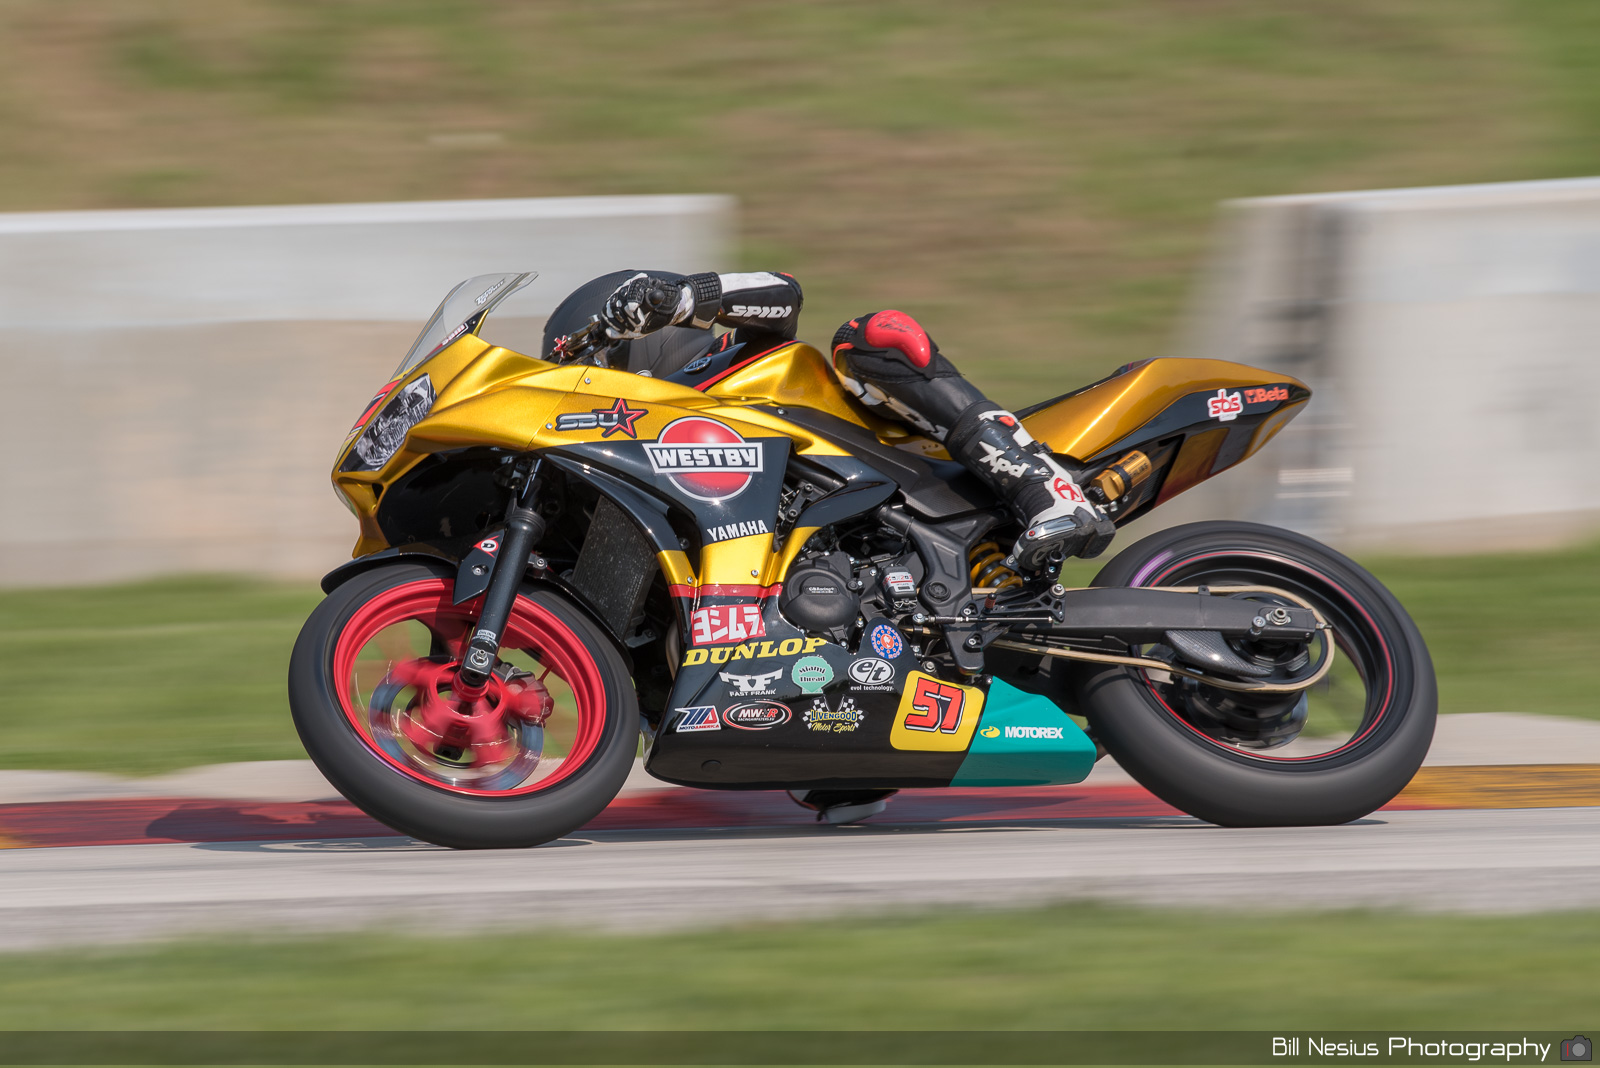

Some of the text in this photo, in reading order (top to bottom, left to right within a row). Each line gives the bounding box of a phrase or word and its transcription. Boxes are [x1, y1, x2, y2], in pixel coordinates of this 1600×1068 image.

[727, 305, 792, 318] SPIDI
[1256, 386, 1289, 402] Beta
[1211, 391, 1240, 414] sbs
[559, 413, 619, 427] SBU
[652, 448, 756, 467] WESTBY
[707, 519, 768, 541] YAMAHA
[694, 606, 760, 643] ヨシムラ
[682, 637, 829, 667] DUNLOP
[750, 688, 777, 696] FRANK
[904, 677, 965, 735] 57
[810, 709, 857, 722] LIVENGOOD
[833, 722, 855, 733] Sports
[1005, 726, 1063, 739] MOTOREX
